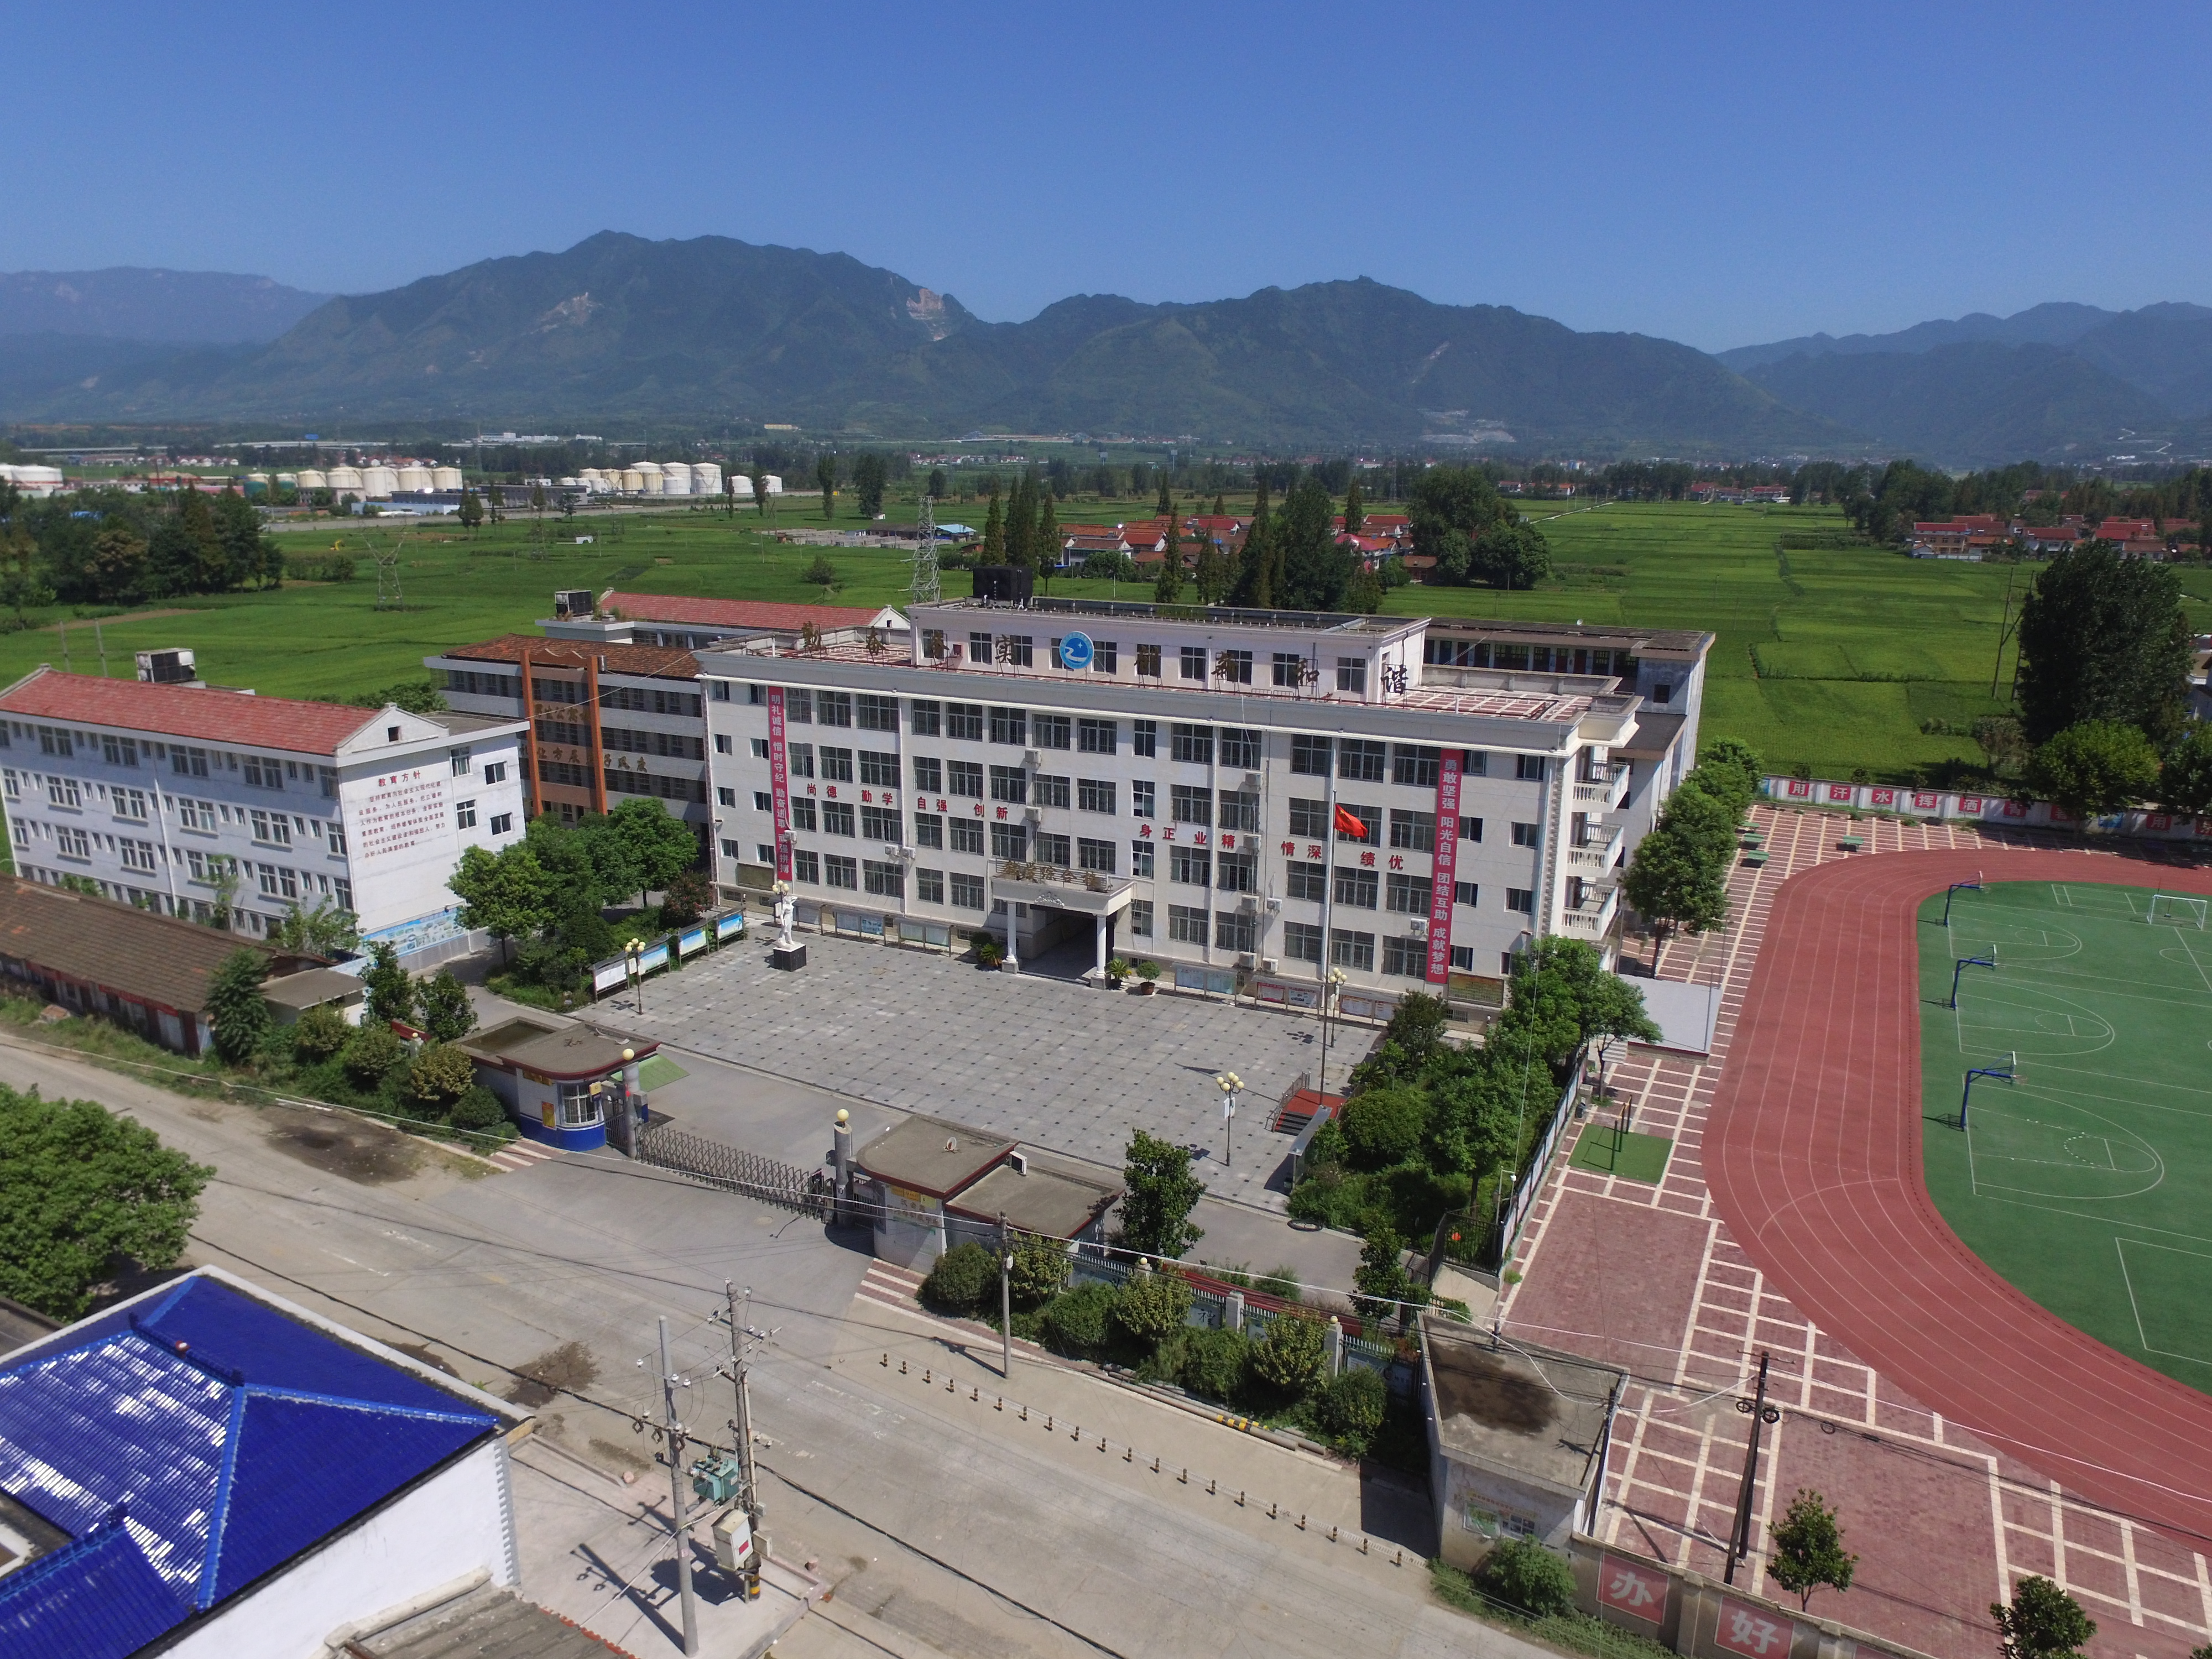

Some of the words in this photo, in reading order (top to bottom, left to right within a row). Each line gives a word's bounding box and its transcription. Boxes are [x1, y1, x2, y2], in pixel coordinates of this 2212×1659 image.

[771, 695, 782, 736] 明礼诚信
[378, 770, 421, 787] 教育方针
[773, 742, 784, 782] 惜时守纪
[807, 783, 838, 799] 尚德
[861, 789, 893, 805] 勤学
[917, 796, 947, 812] 自强
[973, 804, 1008, 821] 创新
[1442, 759, 1458, 810] 勇敢坚强
[1281, 841, 1323, 859] 情深
[1360, 851, 1404, 870] 绩优
[1438, 816, 1454, 866] 阳光自信
[1434, 872, 1450, 921] 团结互助
[1431, 927, 1447, 975] 成就梦想
